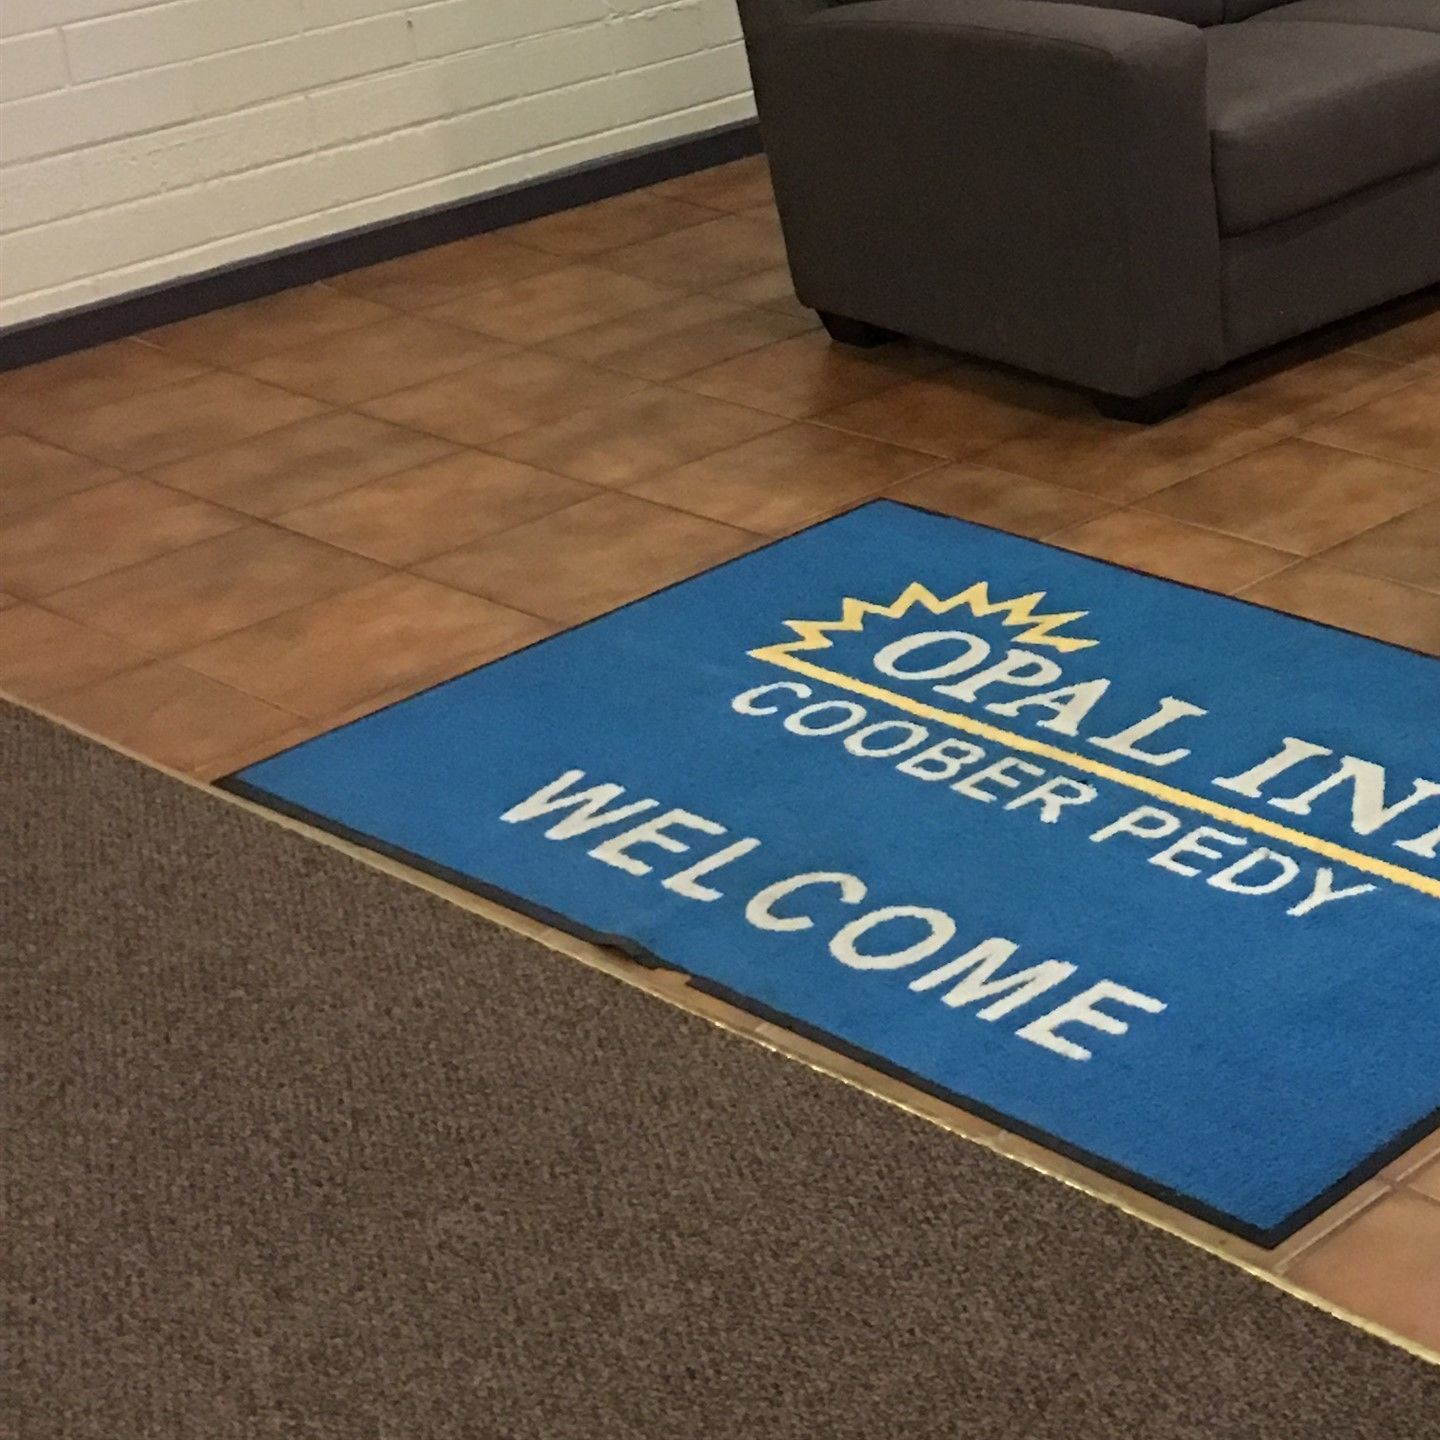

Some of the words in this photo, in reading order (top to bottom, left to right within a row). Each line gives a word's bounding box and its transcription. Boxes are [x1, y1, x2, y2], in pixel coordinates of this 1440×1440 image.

[731, 680, 1100, 824] COOBER
[1089, 803, 1377, 917] PEDY
[872, 628, 1208, 766] OPAL
[499, 769, 1168, 1061] WELCOME
